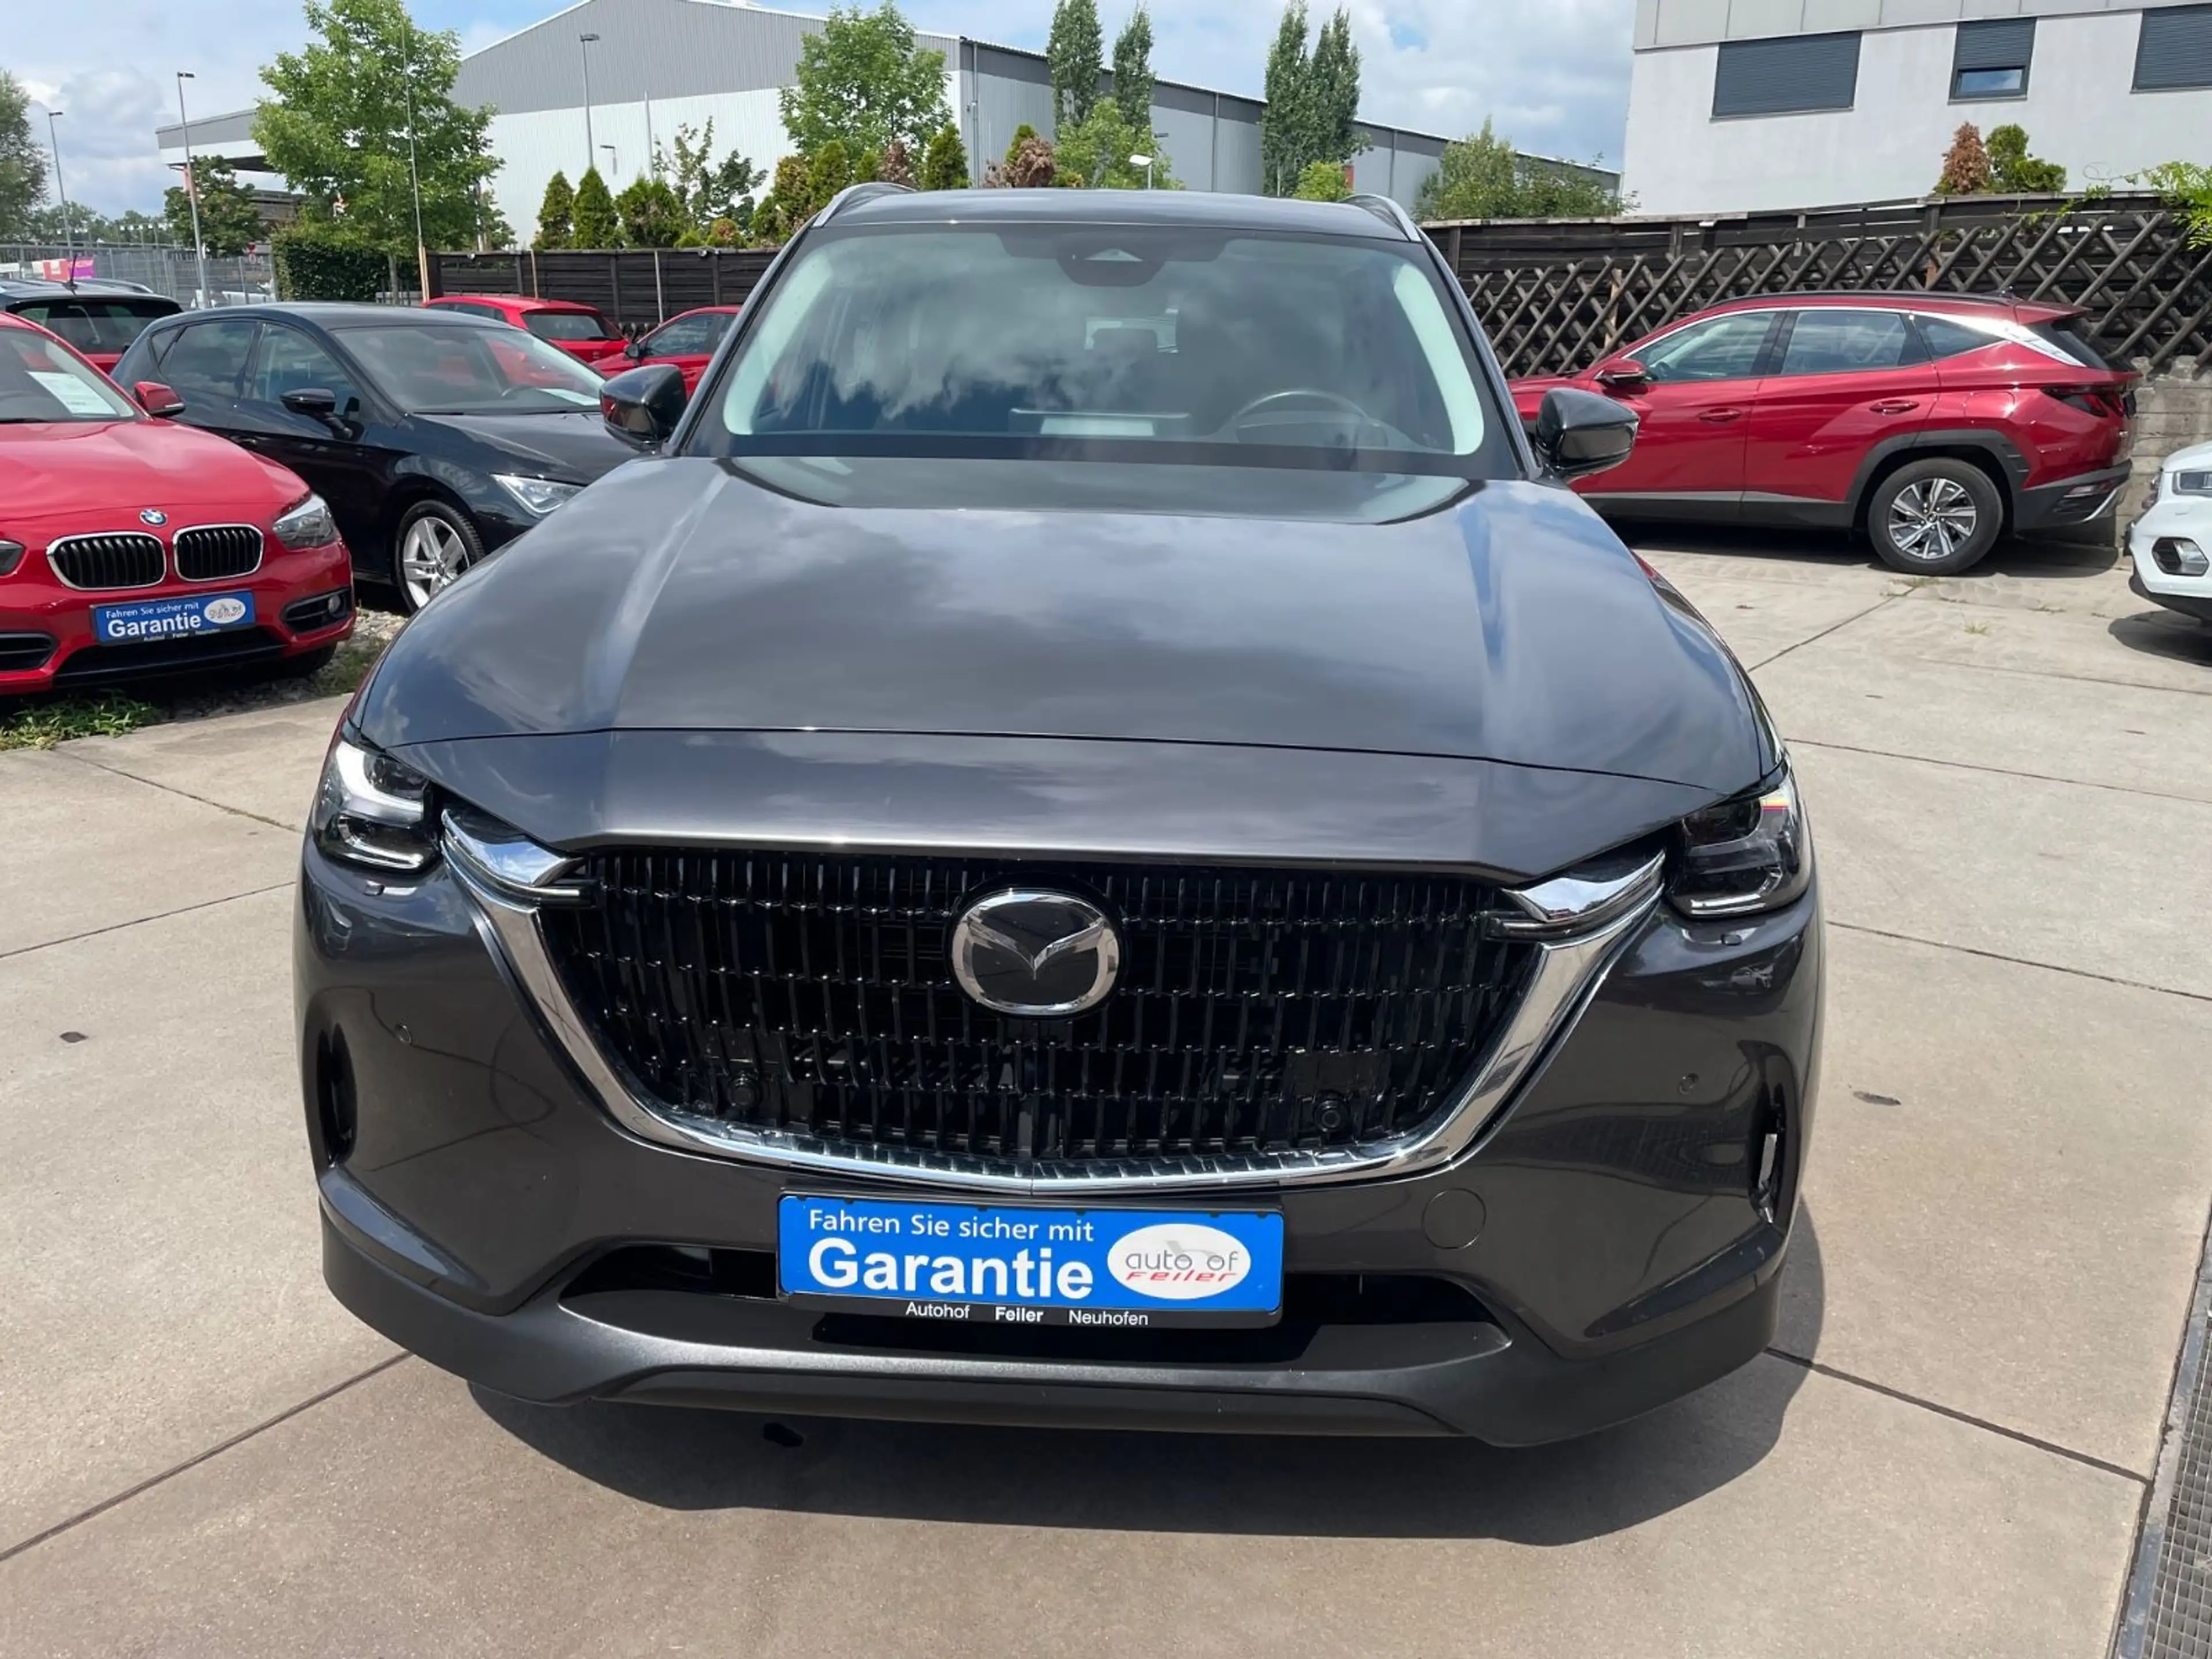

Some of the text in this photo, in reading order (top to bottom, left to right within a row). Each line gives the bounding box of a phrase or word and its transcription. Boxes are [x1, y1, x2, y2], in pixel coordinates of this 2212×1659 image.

[106, 602, 199, 619] Fahren Sie sicher mit
[107, 612, 201, 637] Garantie
[809, 1210, 1094, 1242] Fahren Sie sicher mit
[808, 1238, 1093, 1299] Garantie
[905, 1302, 971, 1319] Autohof
[1069, 1309, 1149, 1325] Neuhofen
